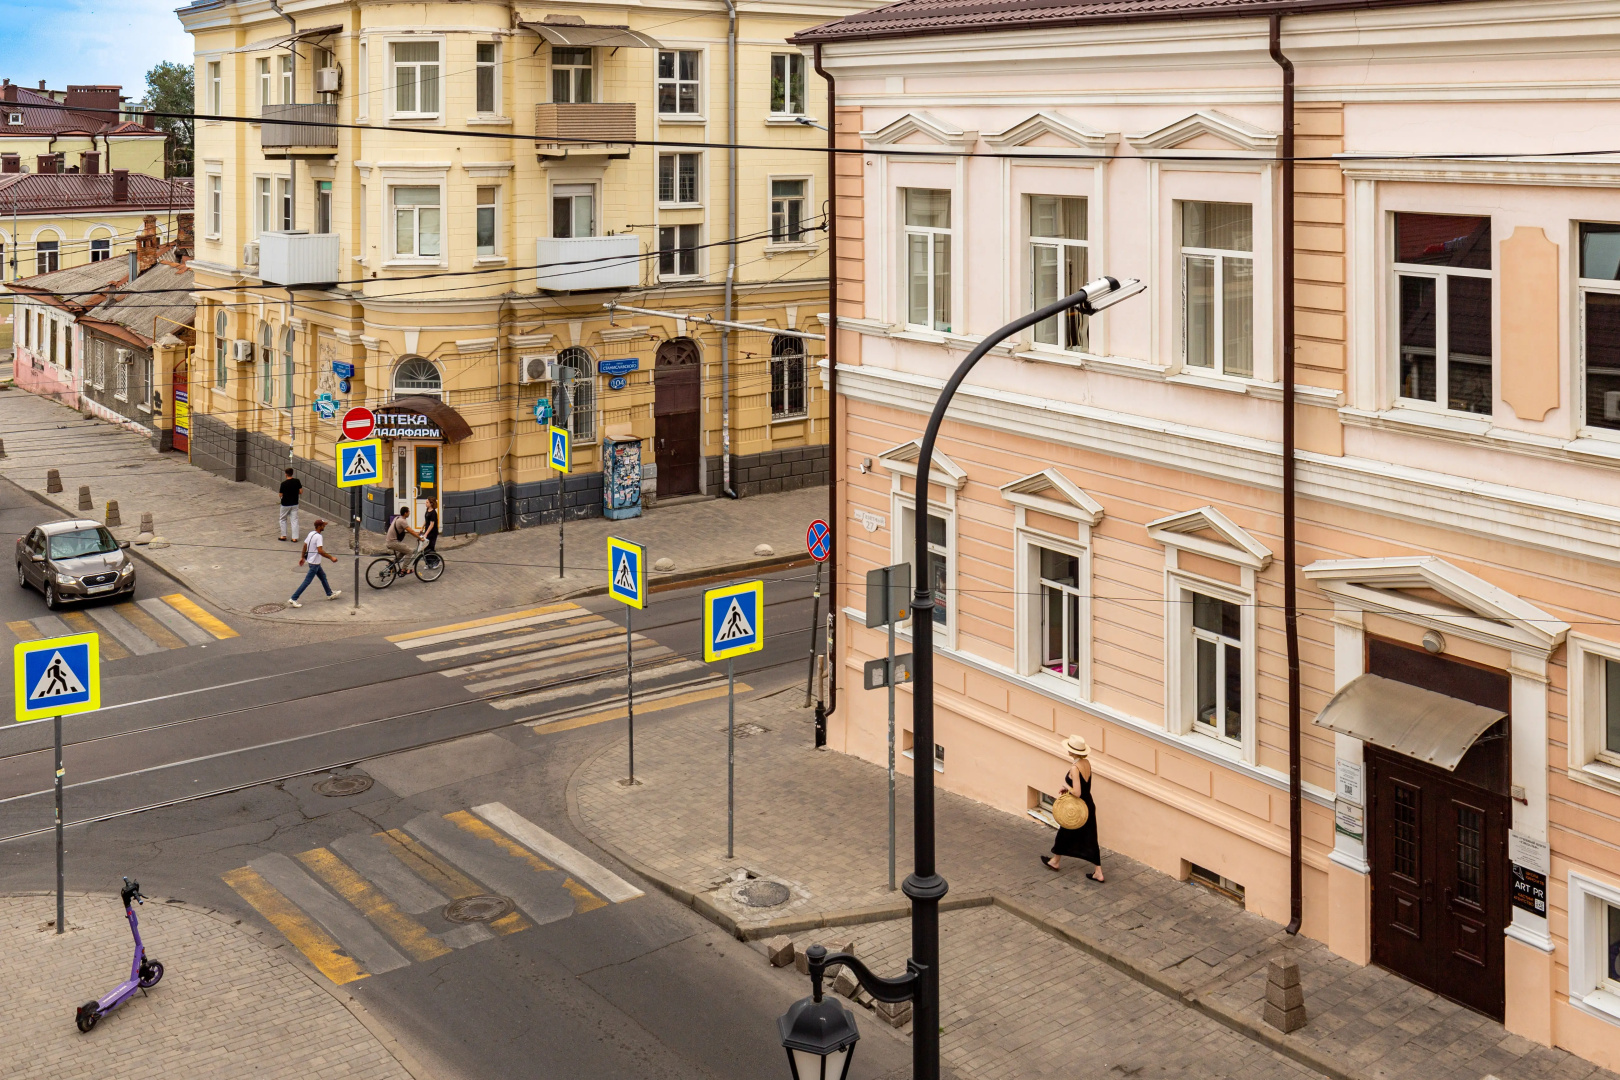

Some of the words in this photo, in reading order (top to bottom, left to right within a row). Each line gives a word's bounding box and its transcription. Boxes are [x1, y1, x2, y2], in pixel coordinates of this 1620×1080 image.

[374, 414, 427, 425] ПТЕКА
[866, 520, 874, 530] 27
[1515, 880, 1531, 893] ART
[1532, 887, 1544, 899] PR
